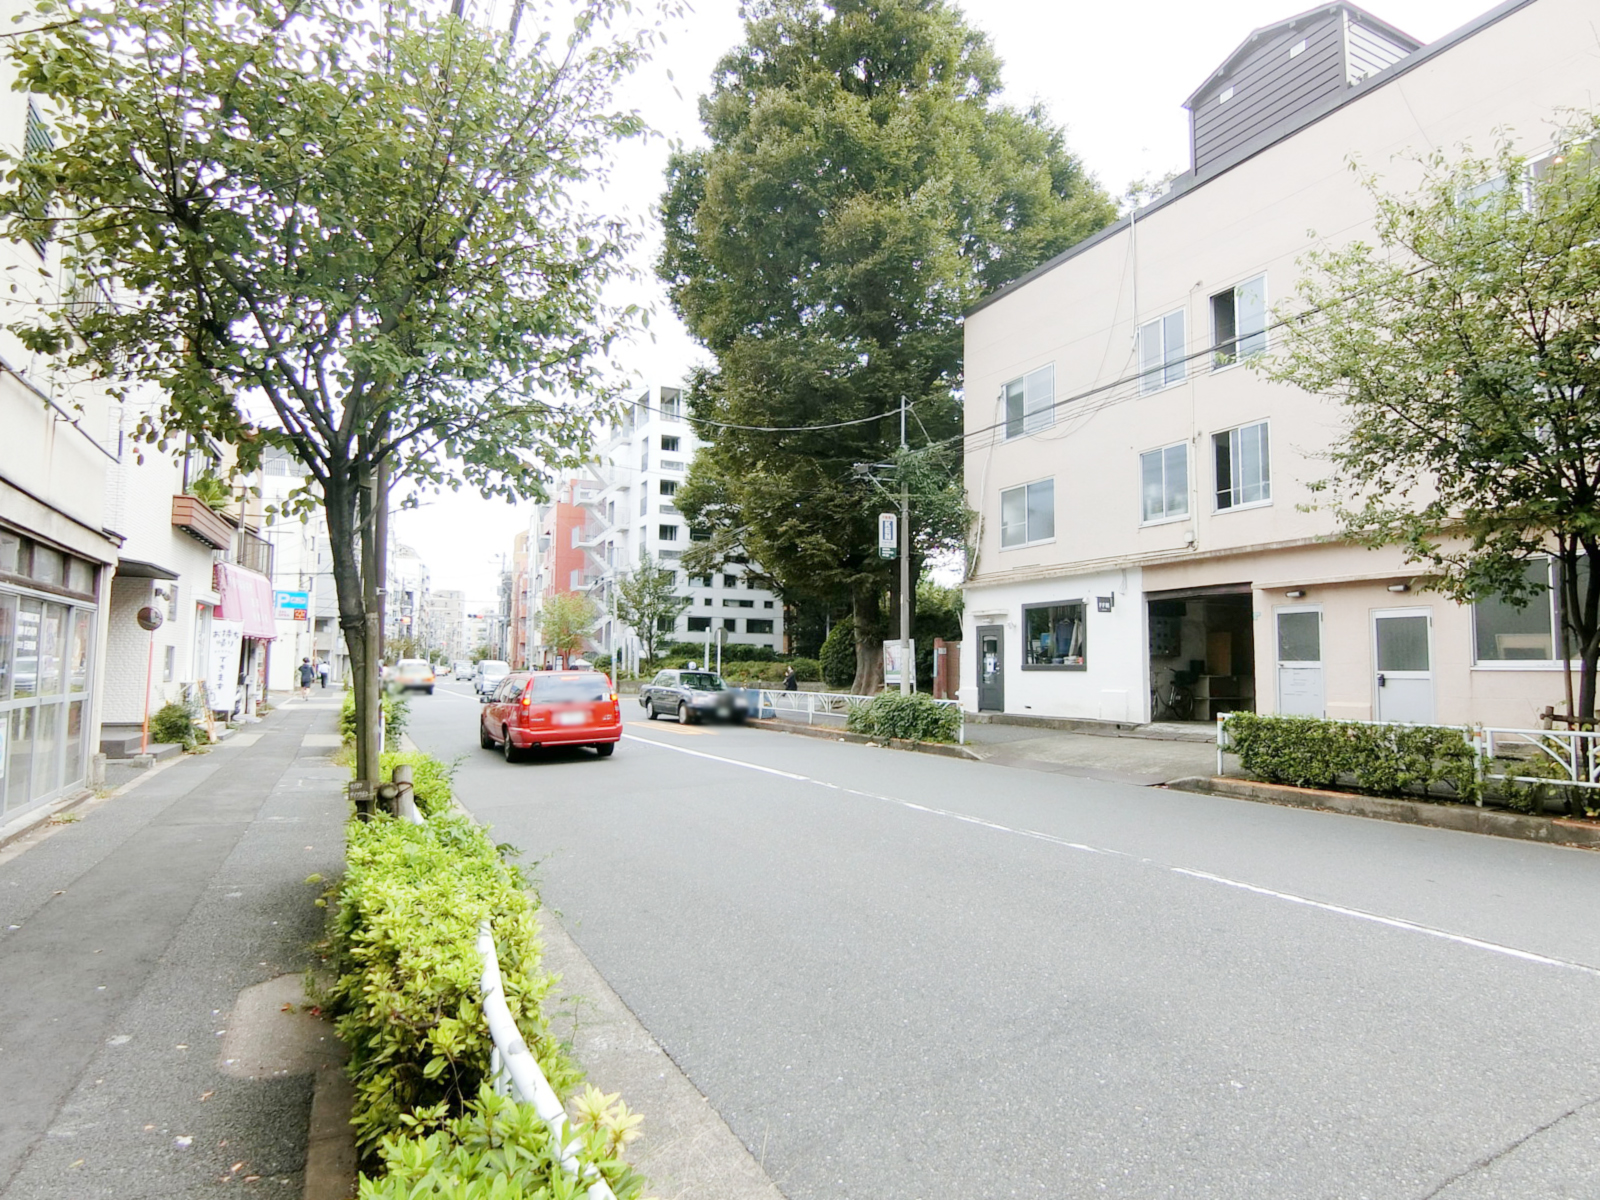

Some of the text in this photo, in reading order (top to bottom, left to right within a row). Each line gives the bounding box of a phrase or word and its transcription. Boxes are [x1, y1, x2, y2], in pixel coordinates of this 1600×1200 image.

[278, 593, 290, 609] P
[216, 656, 227, 690] できます
